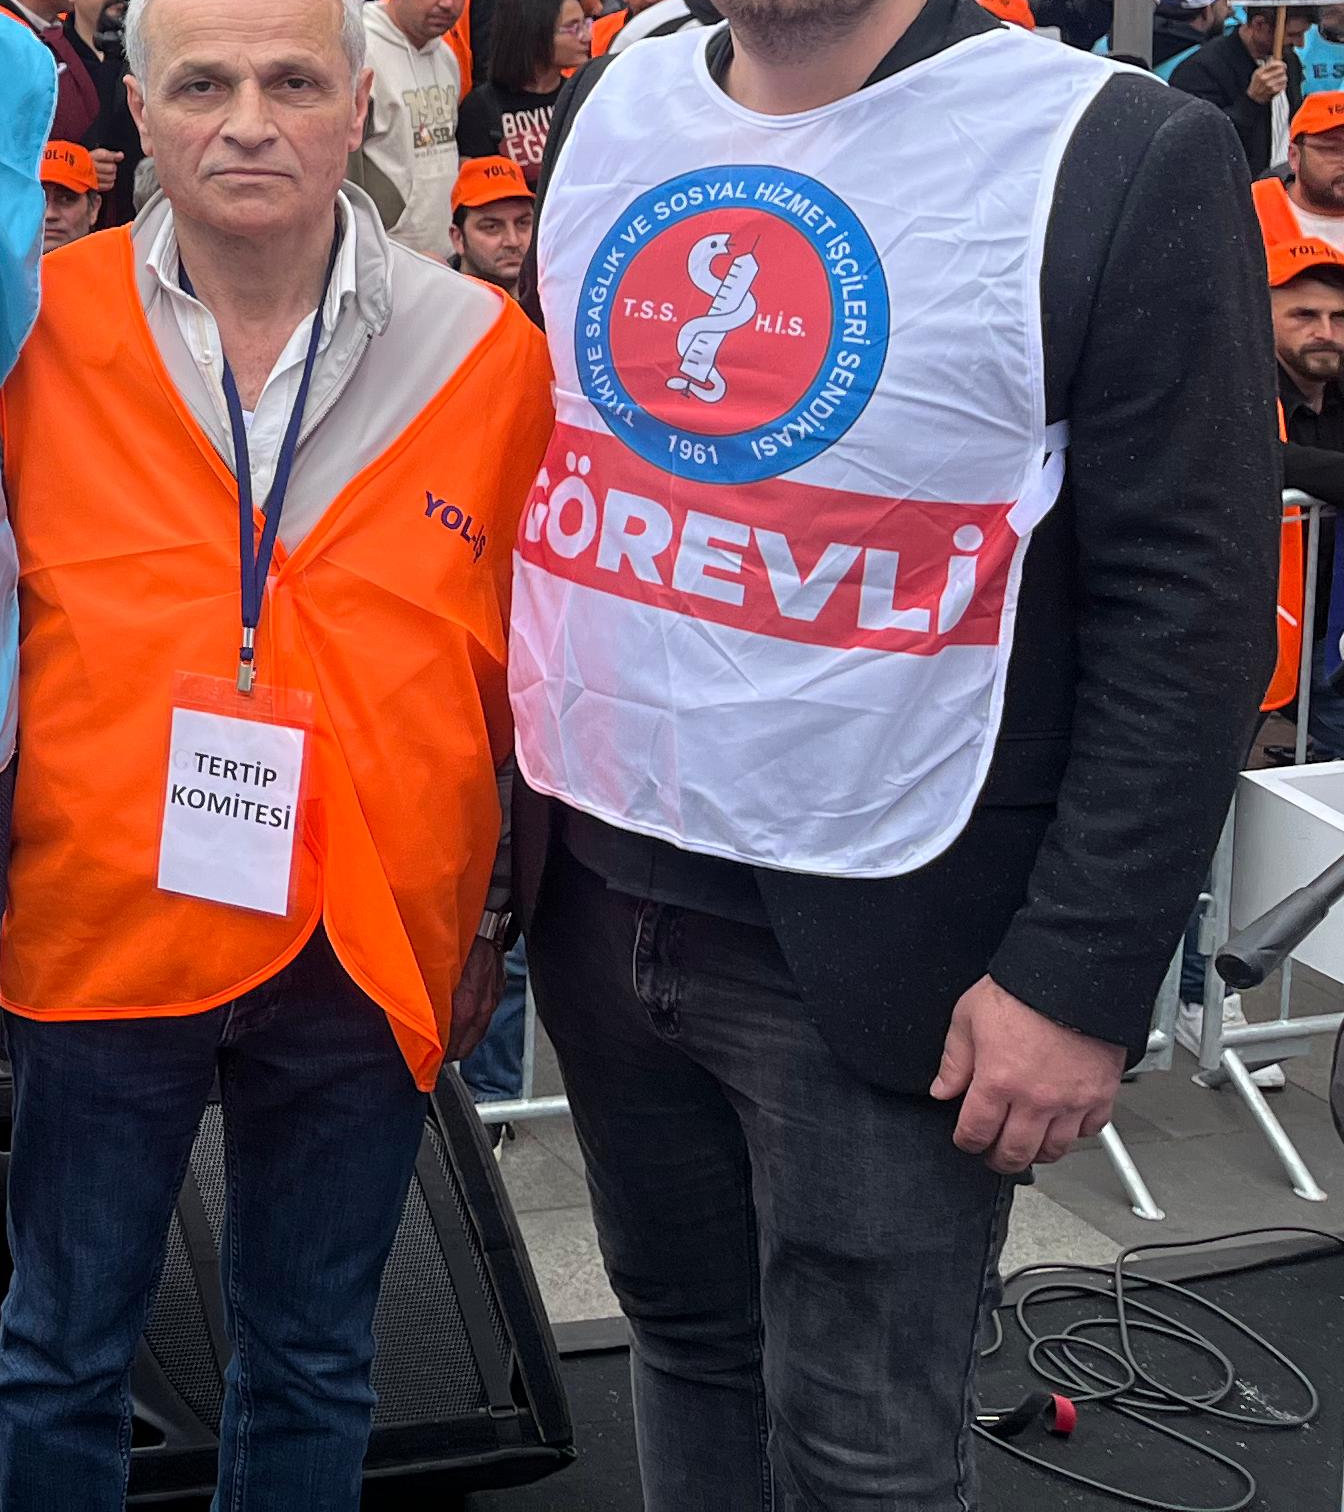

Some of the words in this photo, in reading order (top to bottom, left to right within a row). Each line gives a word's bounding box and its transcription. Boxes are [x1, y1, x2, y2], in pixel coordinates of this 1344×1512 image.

[653, 180, 748, 221] SOSYAL
[754, 179, 838, 241] HİZMET
[620, 216, 652, 245] VE
[586, 247, 626, 338] SAĞLIK
[622, 298, 679, 323] T.S.S.
[826, 230, 871, 348] İŞÇİLERİ
[755, 310, 808, 338] H.İ.S.
[751, 349, 862, 463] SENDİKASI
[666, 434, 719, 465] 1961
[523, 449, 985, 637] GÖREVLİ
[193, 751, 279, 788] TERTİP
[170, 783, 293, 831] KOMİTESİ
